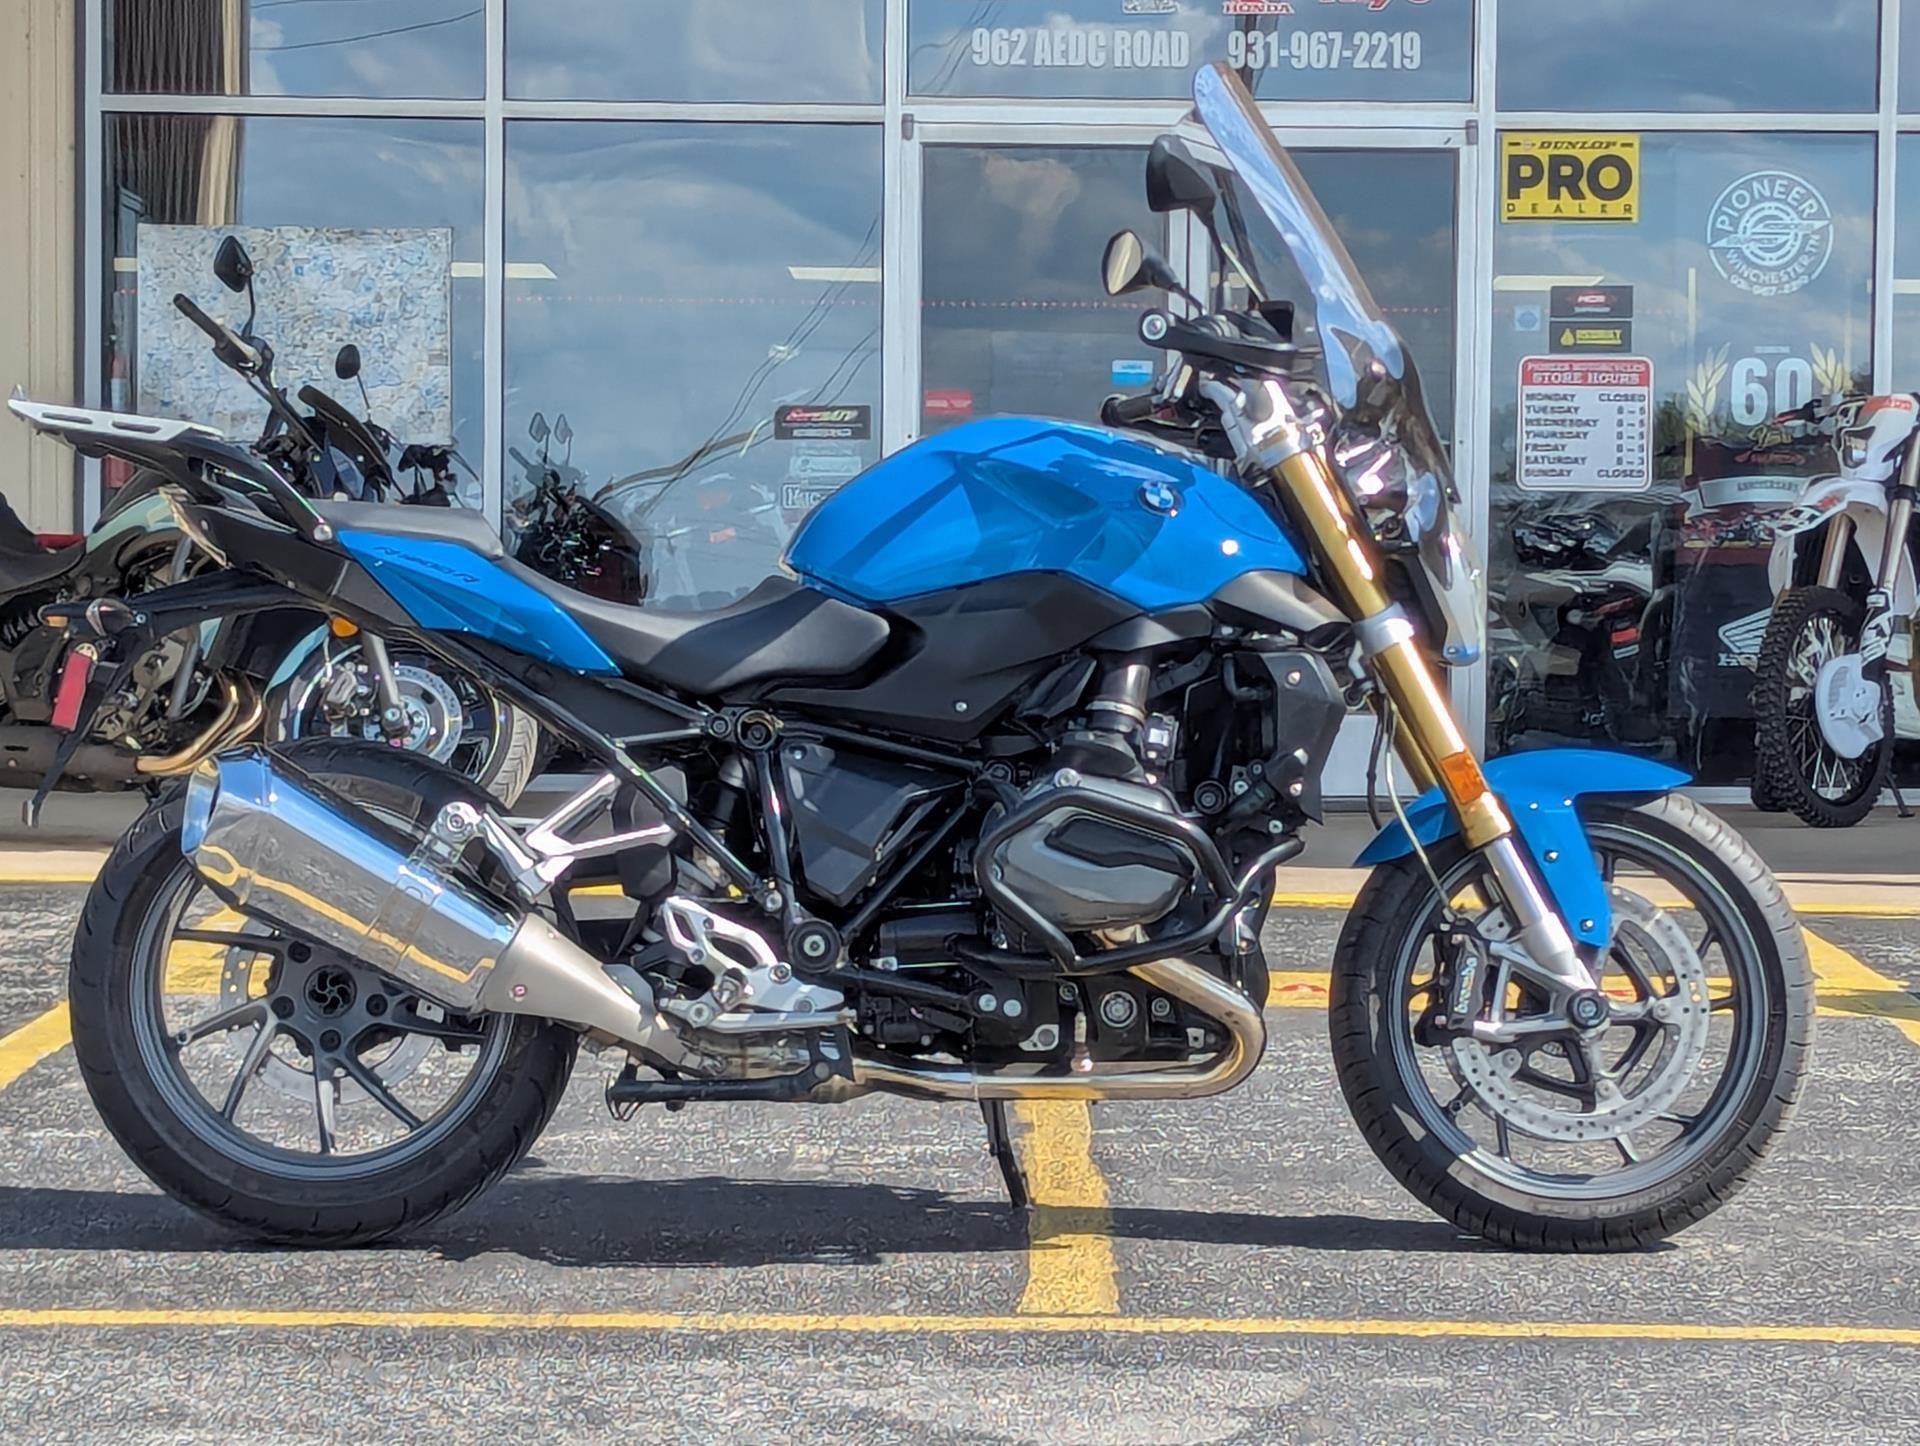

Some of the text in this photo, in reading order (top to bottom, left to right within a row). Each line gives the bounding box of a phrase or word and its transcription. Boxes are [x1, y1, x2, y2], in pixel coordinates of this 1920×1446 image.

[1226, 3, 1292, 13] HONDA
[971, 28, 1422, 69] 962 AEDC ROAD 931-967-2219
[1538, 140, 1617, 150] DUNLOP
[1507, 154, 1633, 201] PRO
[1507, 203, 1633, 214] DEALER
[1716, 178, 1819, 232] PIONEER
[1532, 372, 1640, 384] STORE HOURS
[1730, 357, 1812, 426] 60
[1525, 393, 1647, 402] MONDAY CLOSED
[1525, 405, 1580, 414] TUESDAY
[1525, 418, 1599, 427] WEDNESDAY
[1525, 430, 1589, 439] THURSDAY
[1525, 443, 1567, 452] FRIDAY
[1525, 456, 1588, 464] SATURDAY
[1524, 468, 1645, 478] SUNDAY CLOSED
